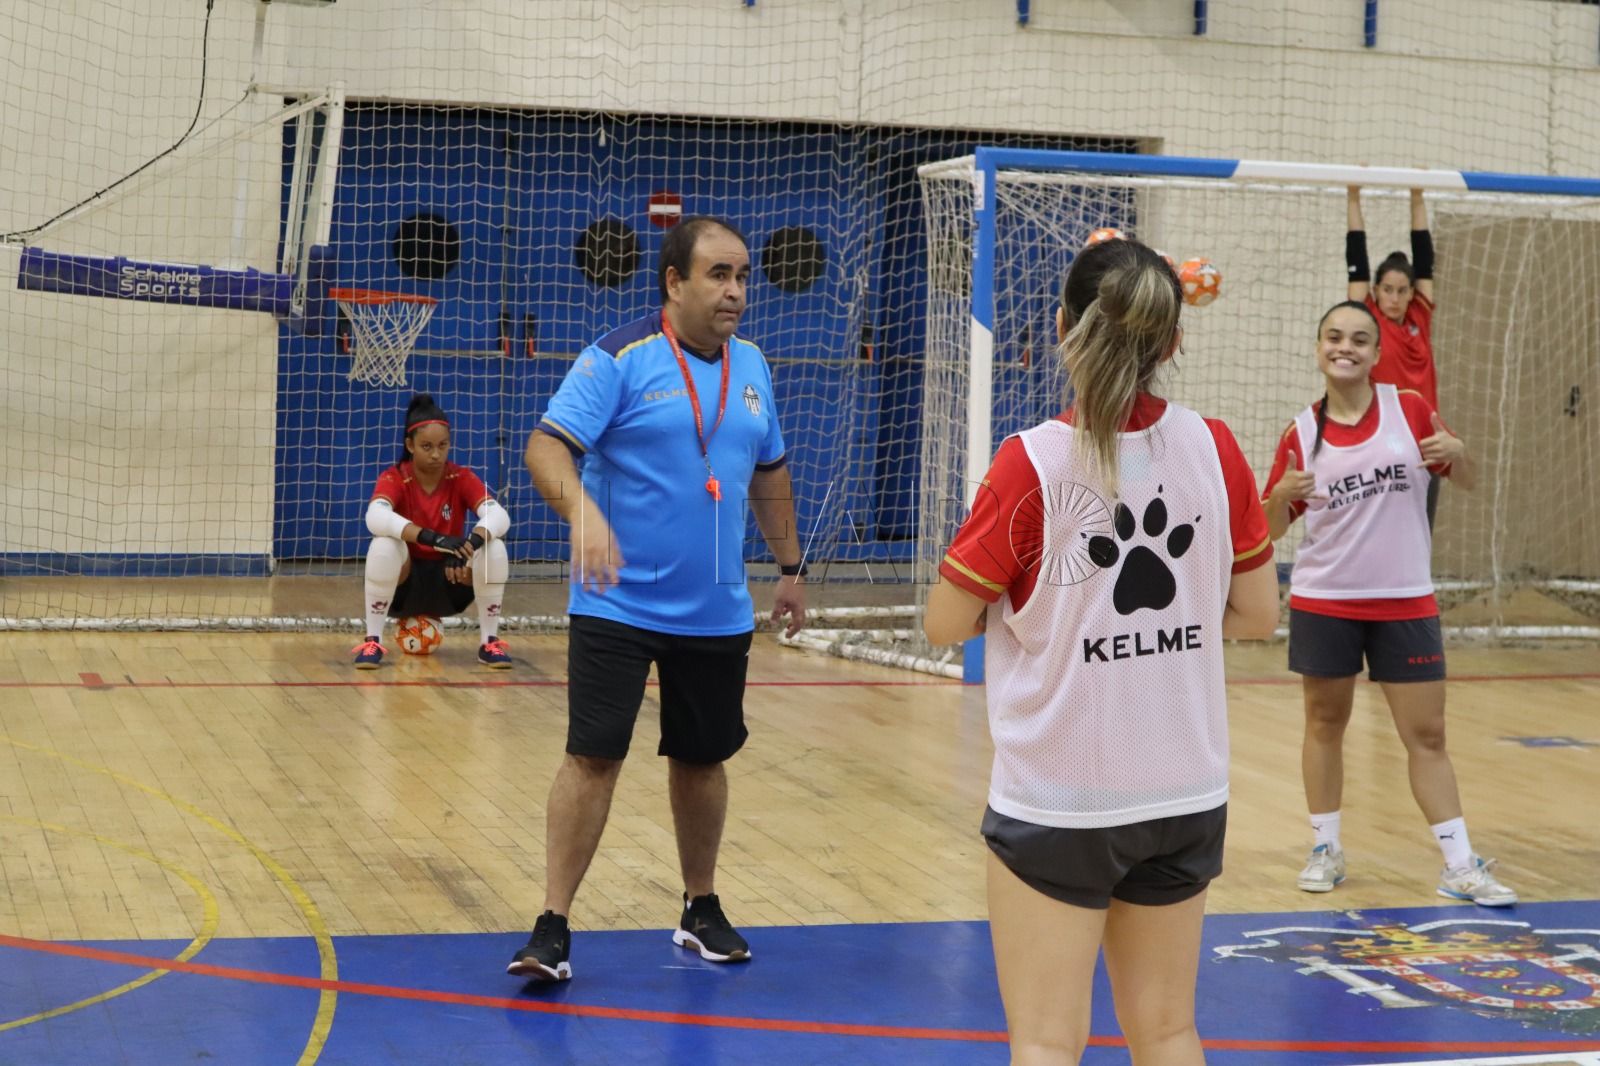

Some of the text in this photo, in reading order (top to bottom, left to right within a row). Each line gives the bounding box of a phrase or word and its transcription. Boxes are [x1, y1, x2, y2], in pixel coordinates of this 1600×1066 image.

[121, 280, 200, 297] Sports
[122, 266, 201, 285] Schelde
[1328, 464, 1407, 497] KELME
[1083, 624, 1202, 663] KELME
